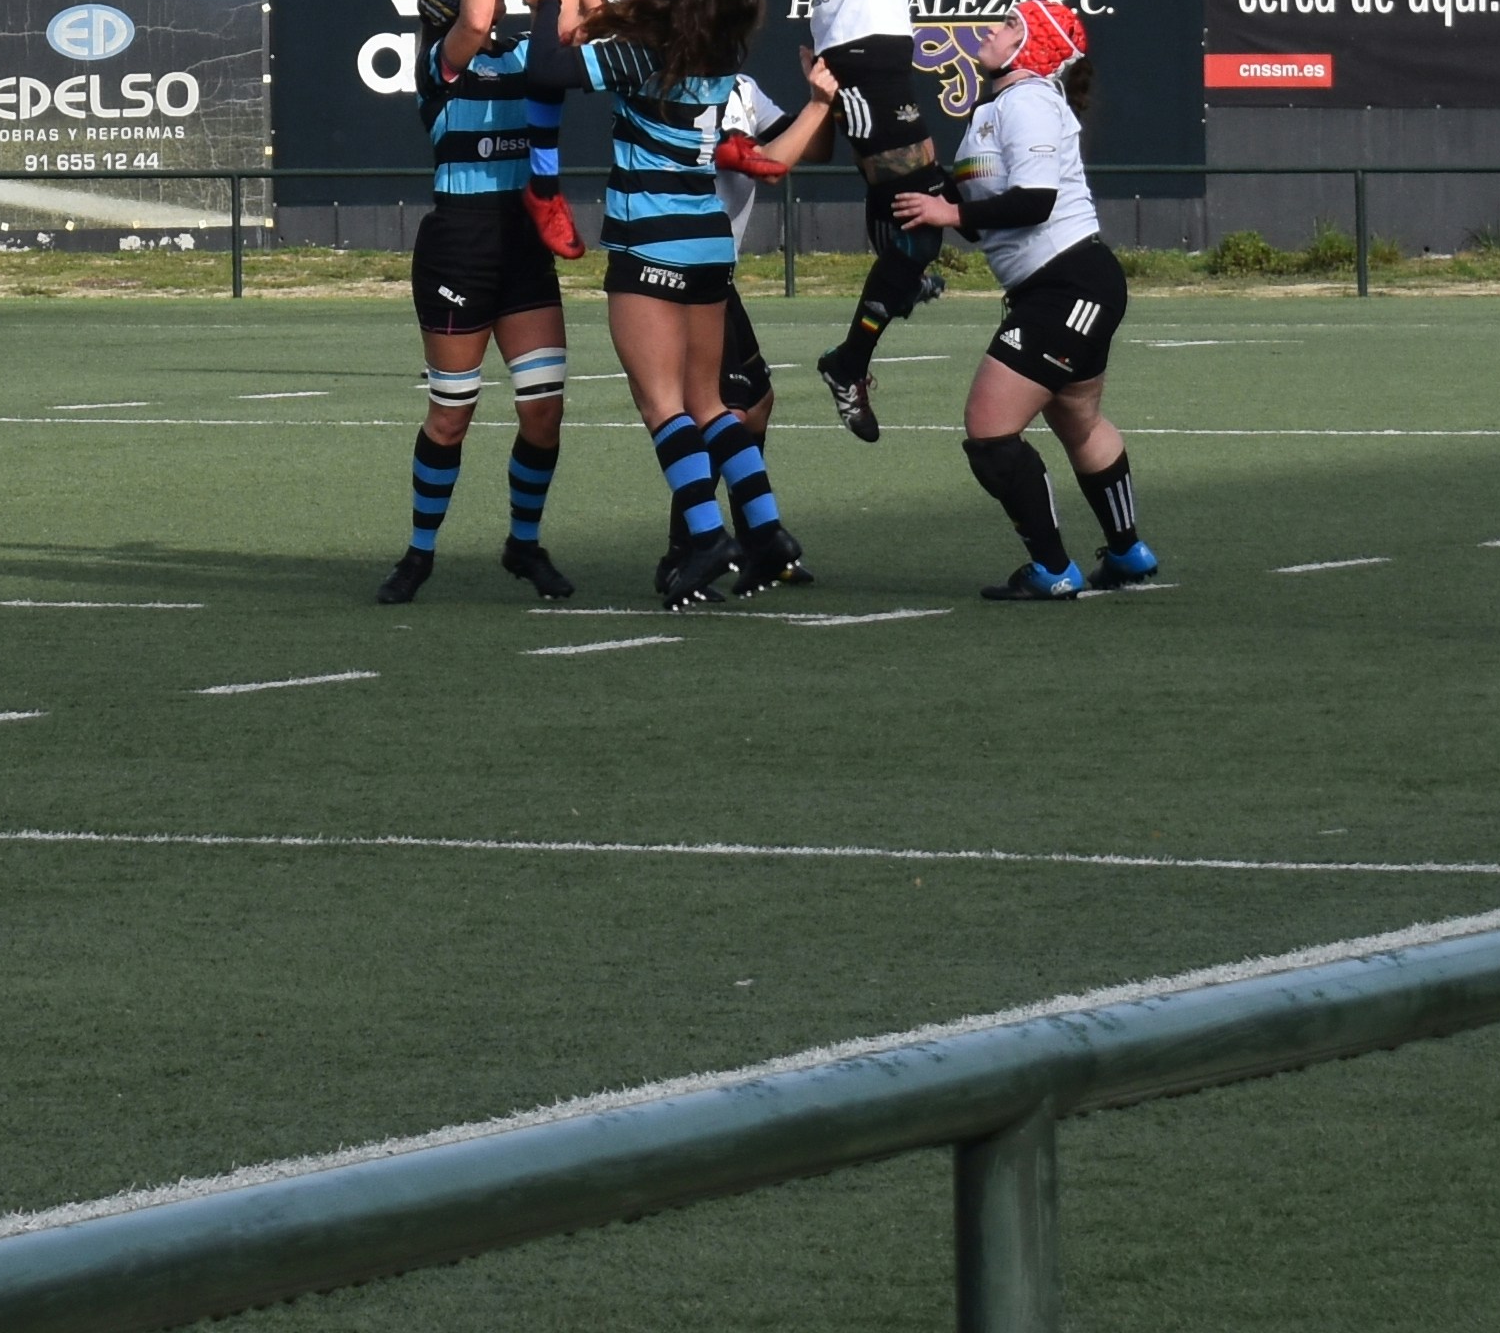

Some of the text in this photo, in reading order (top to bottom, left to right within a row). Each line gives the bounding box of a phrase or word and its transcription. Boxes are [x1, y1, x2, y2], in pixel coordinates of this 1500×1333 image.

[53, 9, 128, 56] ED
[1238, 61, 1325, 78] cnssm.es
[0, 126, 185, 142] OBRAS Y REFORMAS
[25, 152, 159, 171] 91 655 12 44
[640, 272, 686, 290] IBIZA
[437, 285, 466, 307] BLK
